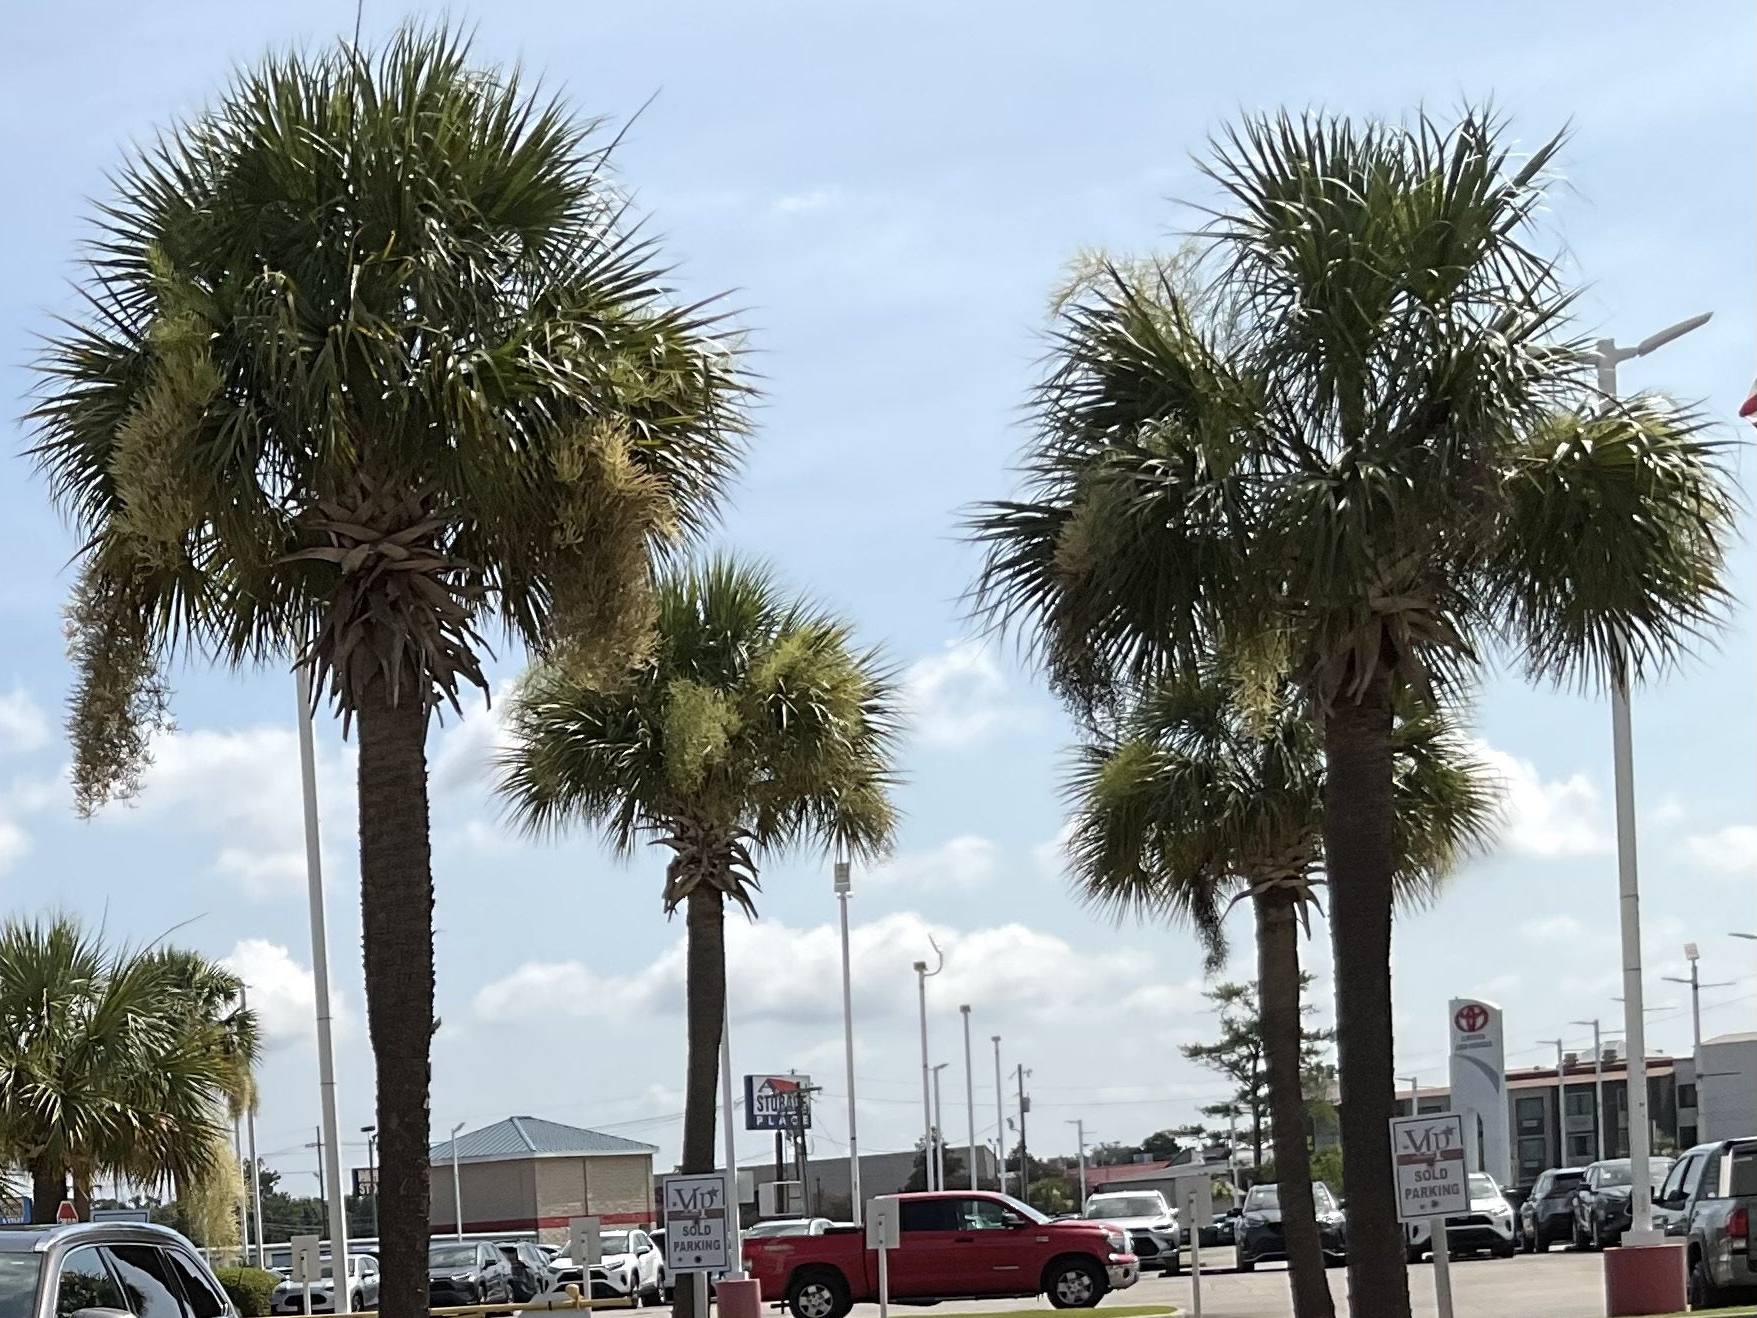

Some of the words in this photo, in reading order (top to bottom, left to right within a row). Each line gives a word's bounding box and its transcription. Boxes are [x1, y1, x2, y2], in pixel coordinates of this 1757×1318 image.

[1414, 1168, 1448, 1182] SOLD
[1405, 1184, 1460, 1200] PARKING
[682, 1225, 711, 1236] SOLD
[673, 1240, 721, 1252] PARKING
